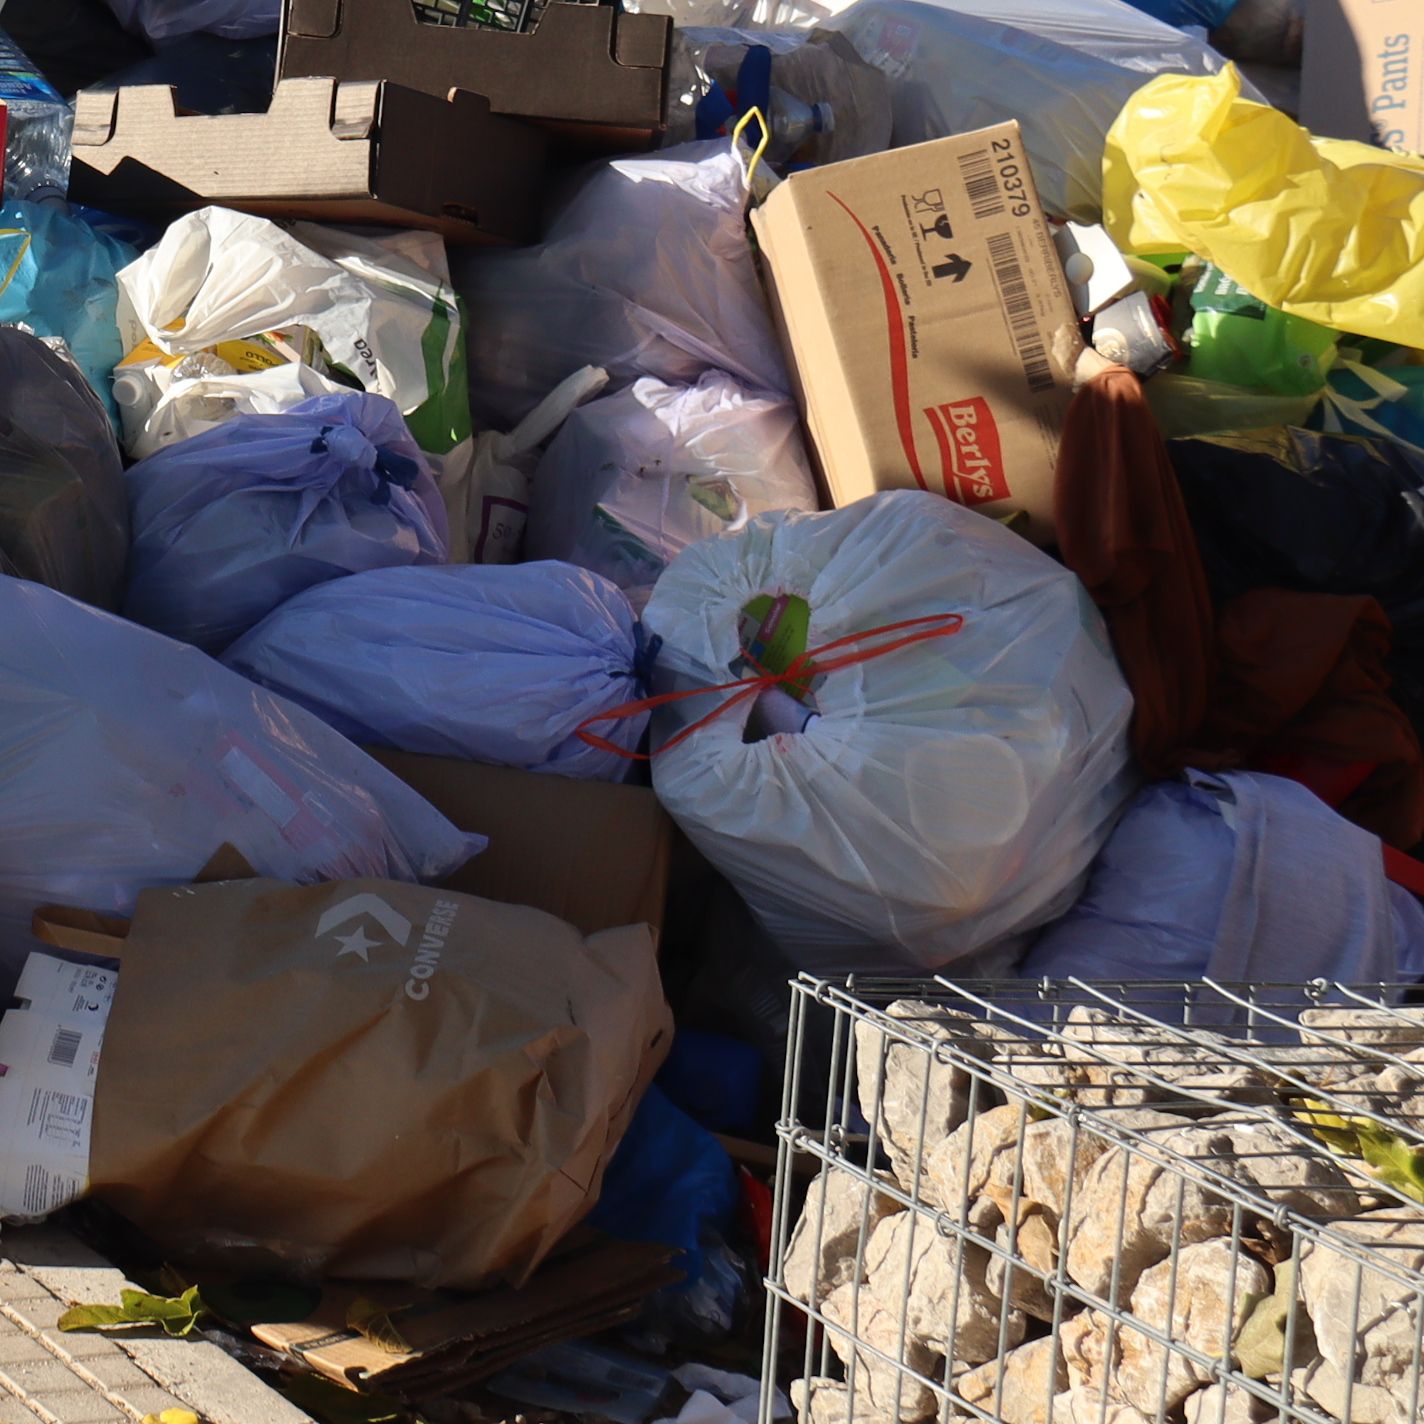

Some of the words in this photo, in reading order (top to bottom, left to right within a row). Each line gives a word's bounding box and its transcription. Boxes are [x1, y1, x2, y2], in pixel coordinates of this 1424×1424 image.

[1372, 34, 1410, 114] Pants
[991, 138, 1031, 218] 210379
[948, 404, 993, 498] Berlys
[405, 899, 459, 1001] CONVERSE
